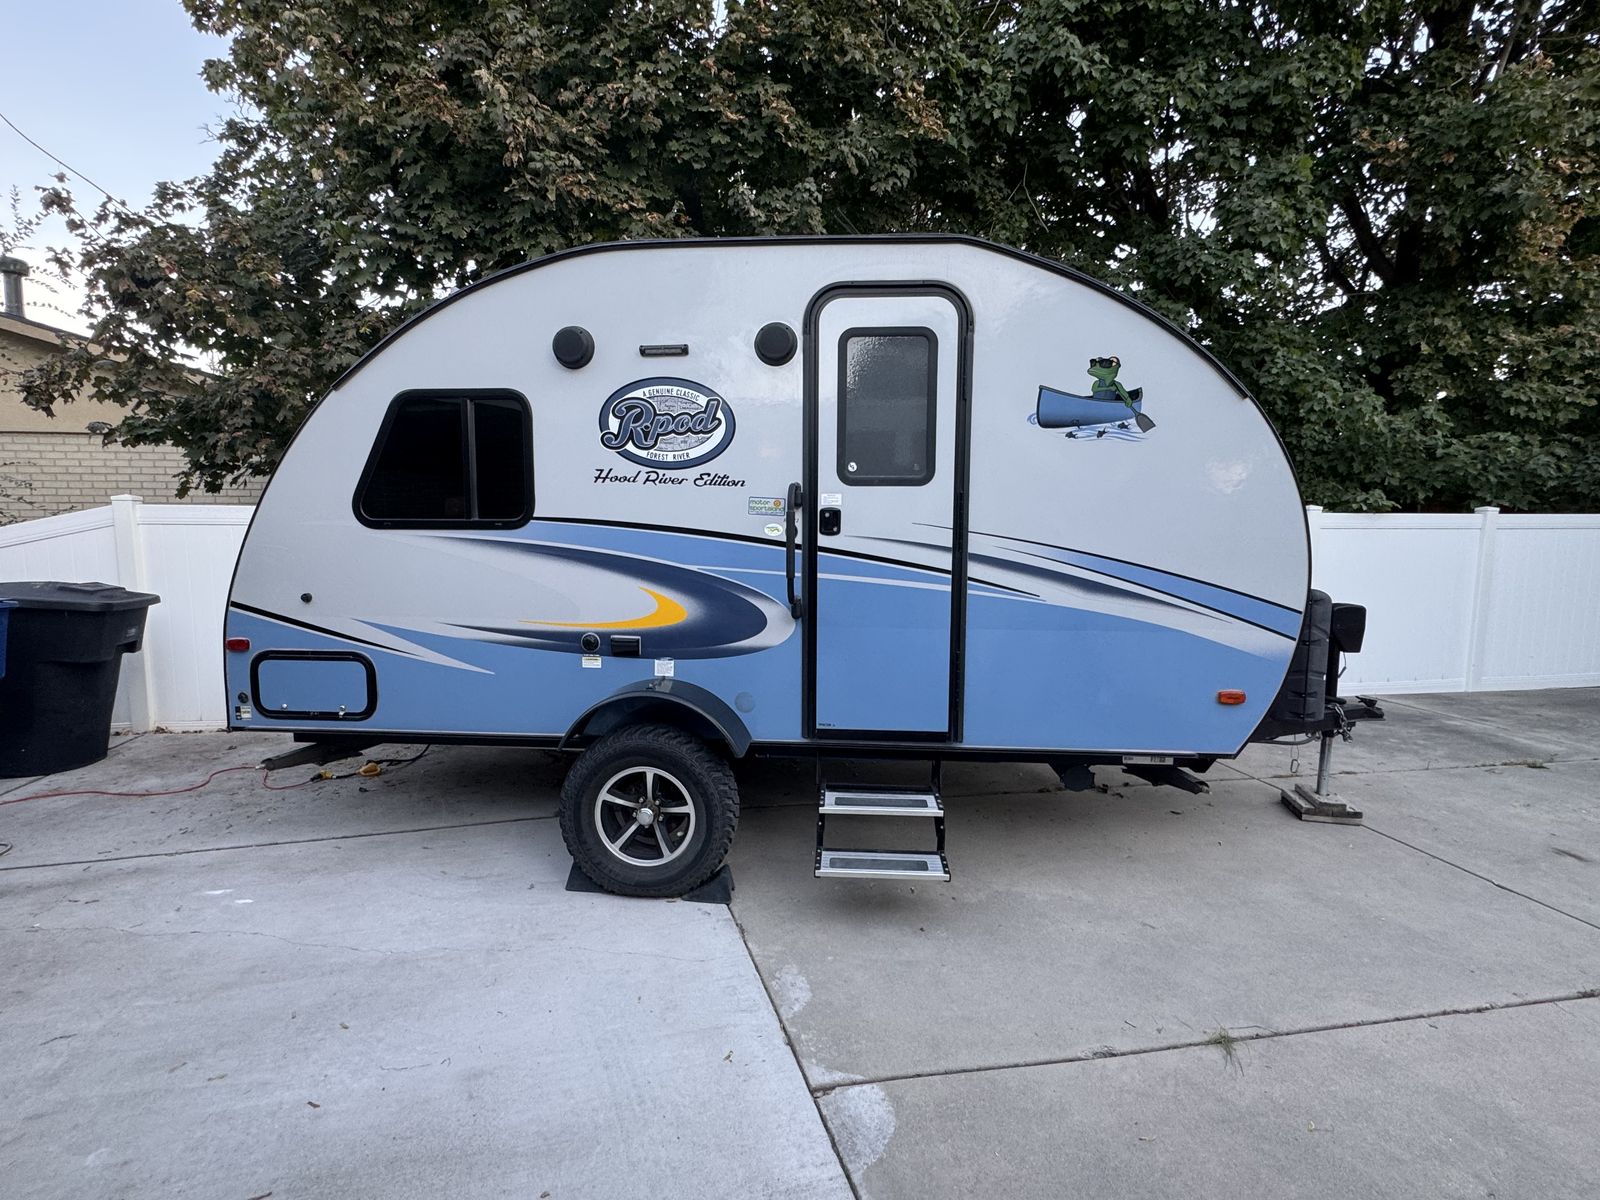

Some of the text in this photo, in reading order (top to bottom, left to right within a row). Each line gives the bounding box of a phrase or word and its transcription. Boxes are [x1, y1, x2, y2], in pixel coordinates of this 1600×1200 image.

[642, 388, 700, 401] A GENUINE CLASSIC
[646, 451, 690, 461] FOREST RIVER
[594, 468, 746, 488] Hood River Edition
